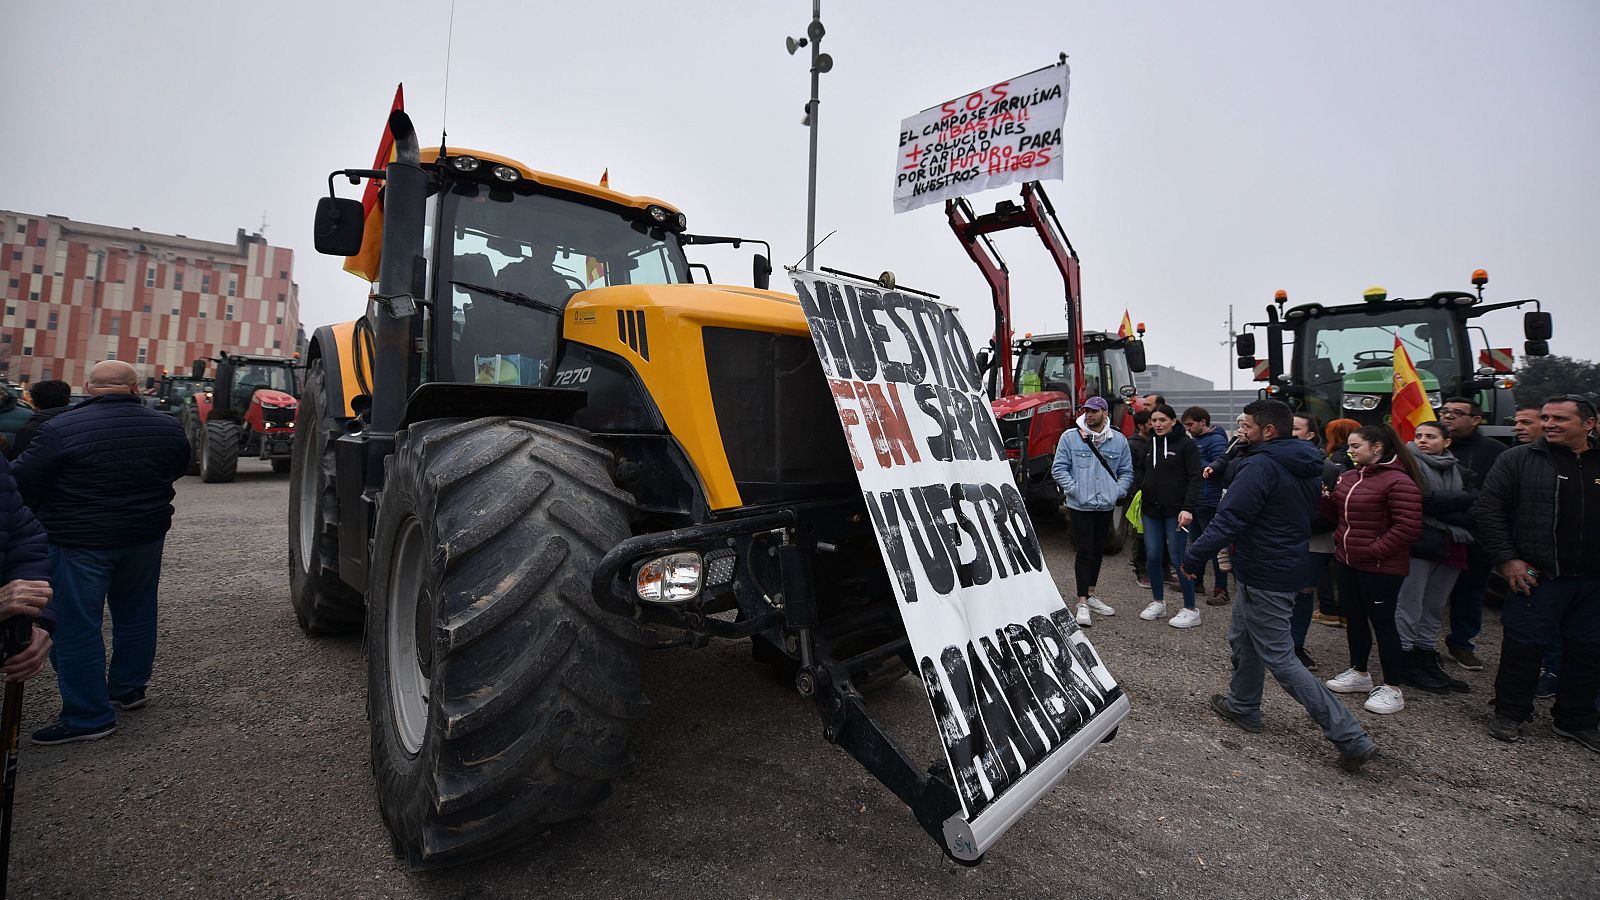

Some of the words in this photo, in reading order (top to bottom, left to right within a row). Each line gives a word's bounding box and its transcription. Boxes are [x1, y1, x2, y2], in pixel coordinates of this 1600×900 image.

[898, 169, 926, 187] POR
[929, 163, 947, 177] UN
[950, 145, 1012, 172] FUTURO
[1019, 128, 1061, 152] PARA
[899, 130, 918, 147] EL
[912, 166, 980, 196] NUESTROS
[793, 277, 984, 393] NUESTRO
[553, 366, 592, 386] 7270
[830, 379, 921, 471] FIN
[864, 483, 1044, 603] VUESTRO
[921, 607, 1120, 813] HAMBRE
